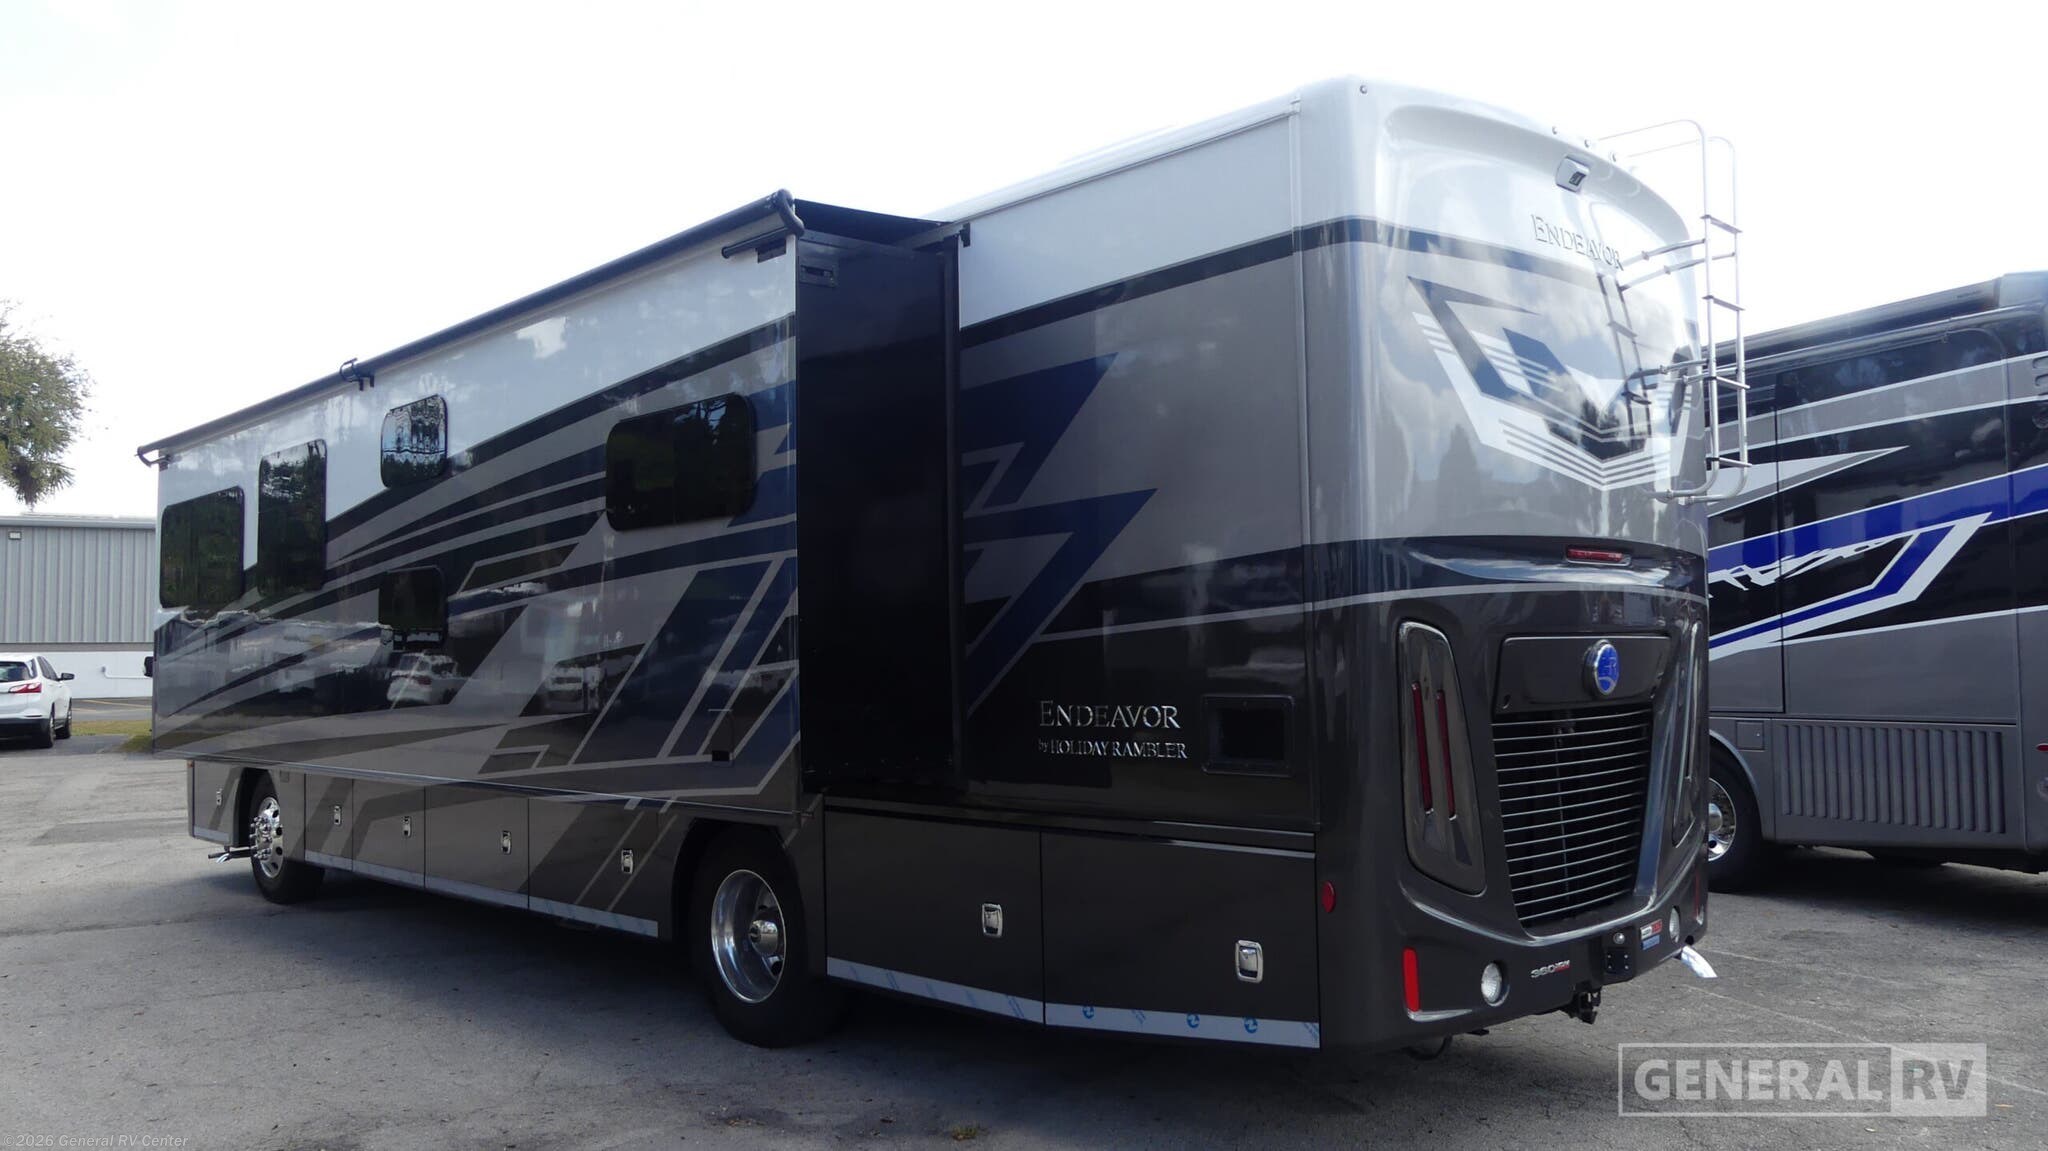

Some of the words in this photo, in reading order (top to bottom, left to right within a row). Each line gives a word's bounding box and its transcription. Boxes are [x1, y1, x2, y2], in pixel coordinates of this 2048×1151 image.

[1531, 214, 1624, 271] ENDEAVOR
[1039, 700, 1181, 729] ENDEAVOR
[1050, 740, 1110, 756] HOLIDAY
[1112, 741, 1188, 759] RAMBLER
